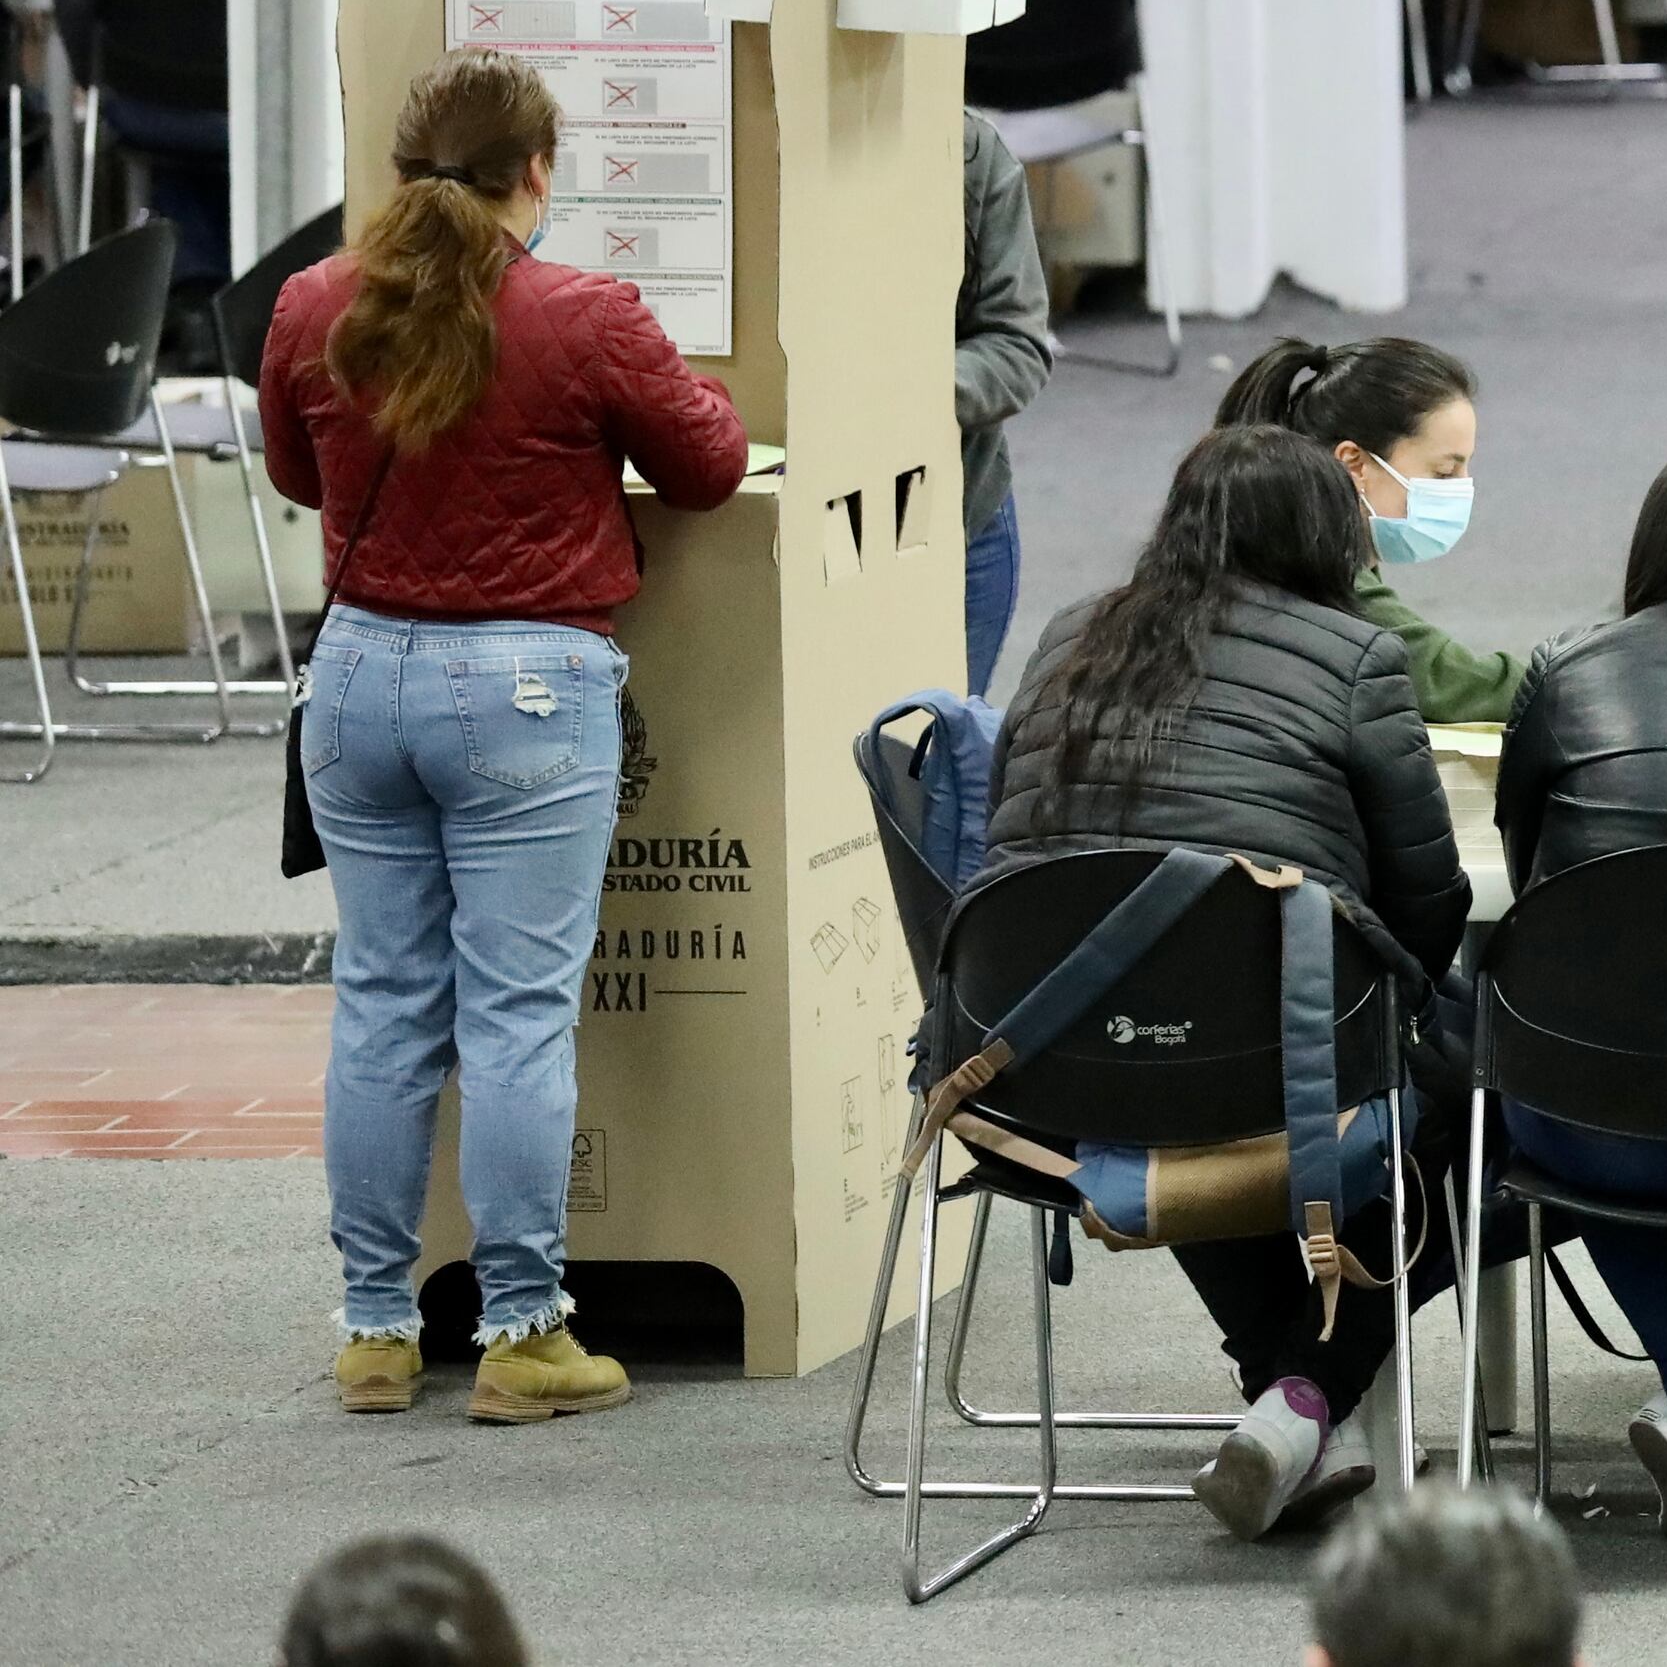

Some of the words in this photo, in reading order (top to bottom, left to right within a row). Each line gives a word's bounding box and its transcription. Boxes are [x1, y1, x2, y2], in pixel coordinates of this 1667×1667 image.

[602, 875, 680, 892] STADO
[689, 875, 751, 892] CIVIL
[593, 972, 646, 1011] XXI
[1137, 1023, 1186, 1035] corferias
